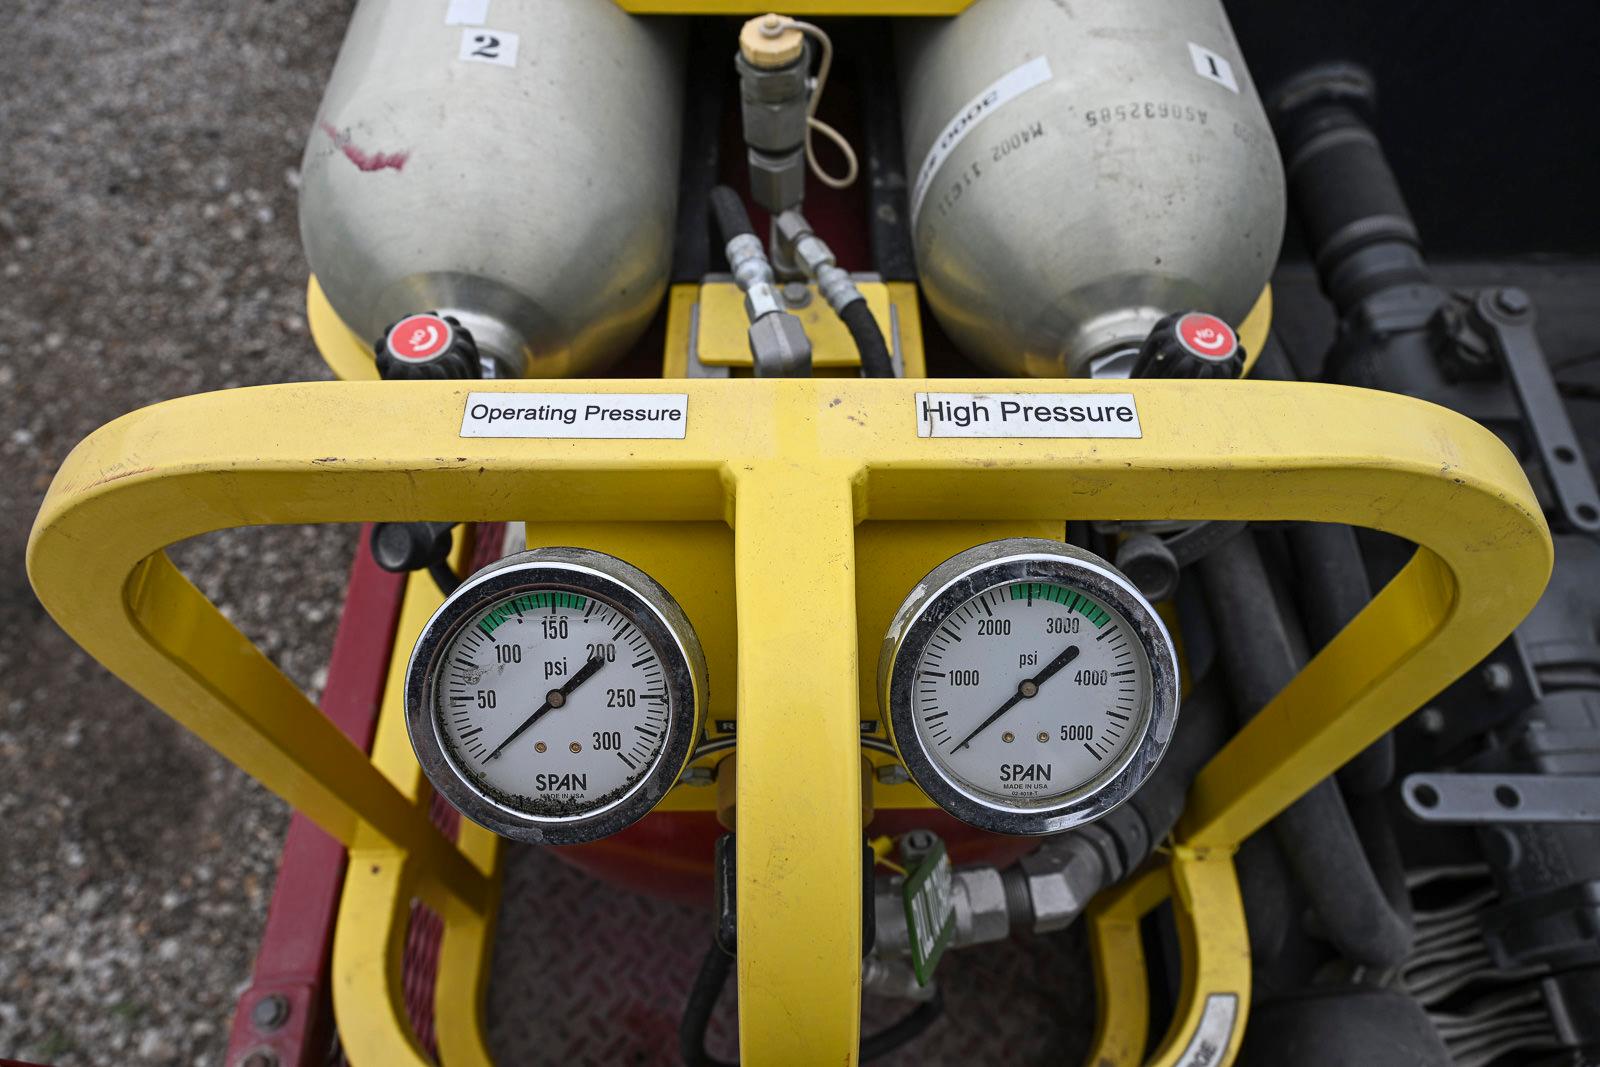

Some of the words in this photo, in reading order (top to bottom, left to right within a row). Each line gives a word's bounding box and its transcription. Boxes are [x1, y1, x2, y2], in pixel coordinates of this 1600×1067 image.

[471, 34, 501, 59] 2
[1203, 55, 1224, 80] 1
[470, 403, 578, 425] Operating
[584, 405, 682, 422] Pressure
[922, 401, 990, 427] High
[1001, 401, 1134, 423] Pressure
[541, 619, 569, 640] 150
[977, 619, 1011, 636] 2000
[1046, 618, 1080, 635] 3000
[494, 644, 522, 664] 100
[586, 643, 616, 663] 200
[1018, 650, 1038, 669] psi
[544, 656, 568, 681] psi
[949, 669, 980, 687] 1000
[1074, 669, 1109, 686] 4000
[476, 689, 497, 709] 50
[606, 688, 636, 708] 250
[592, 731, 622, 751] 300
[1060, 724, 1094, 741] 5000
[535, 773, 587, 792] SPAN
[999, 763, 1052, 782] SPAN
